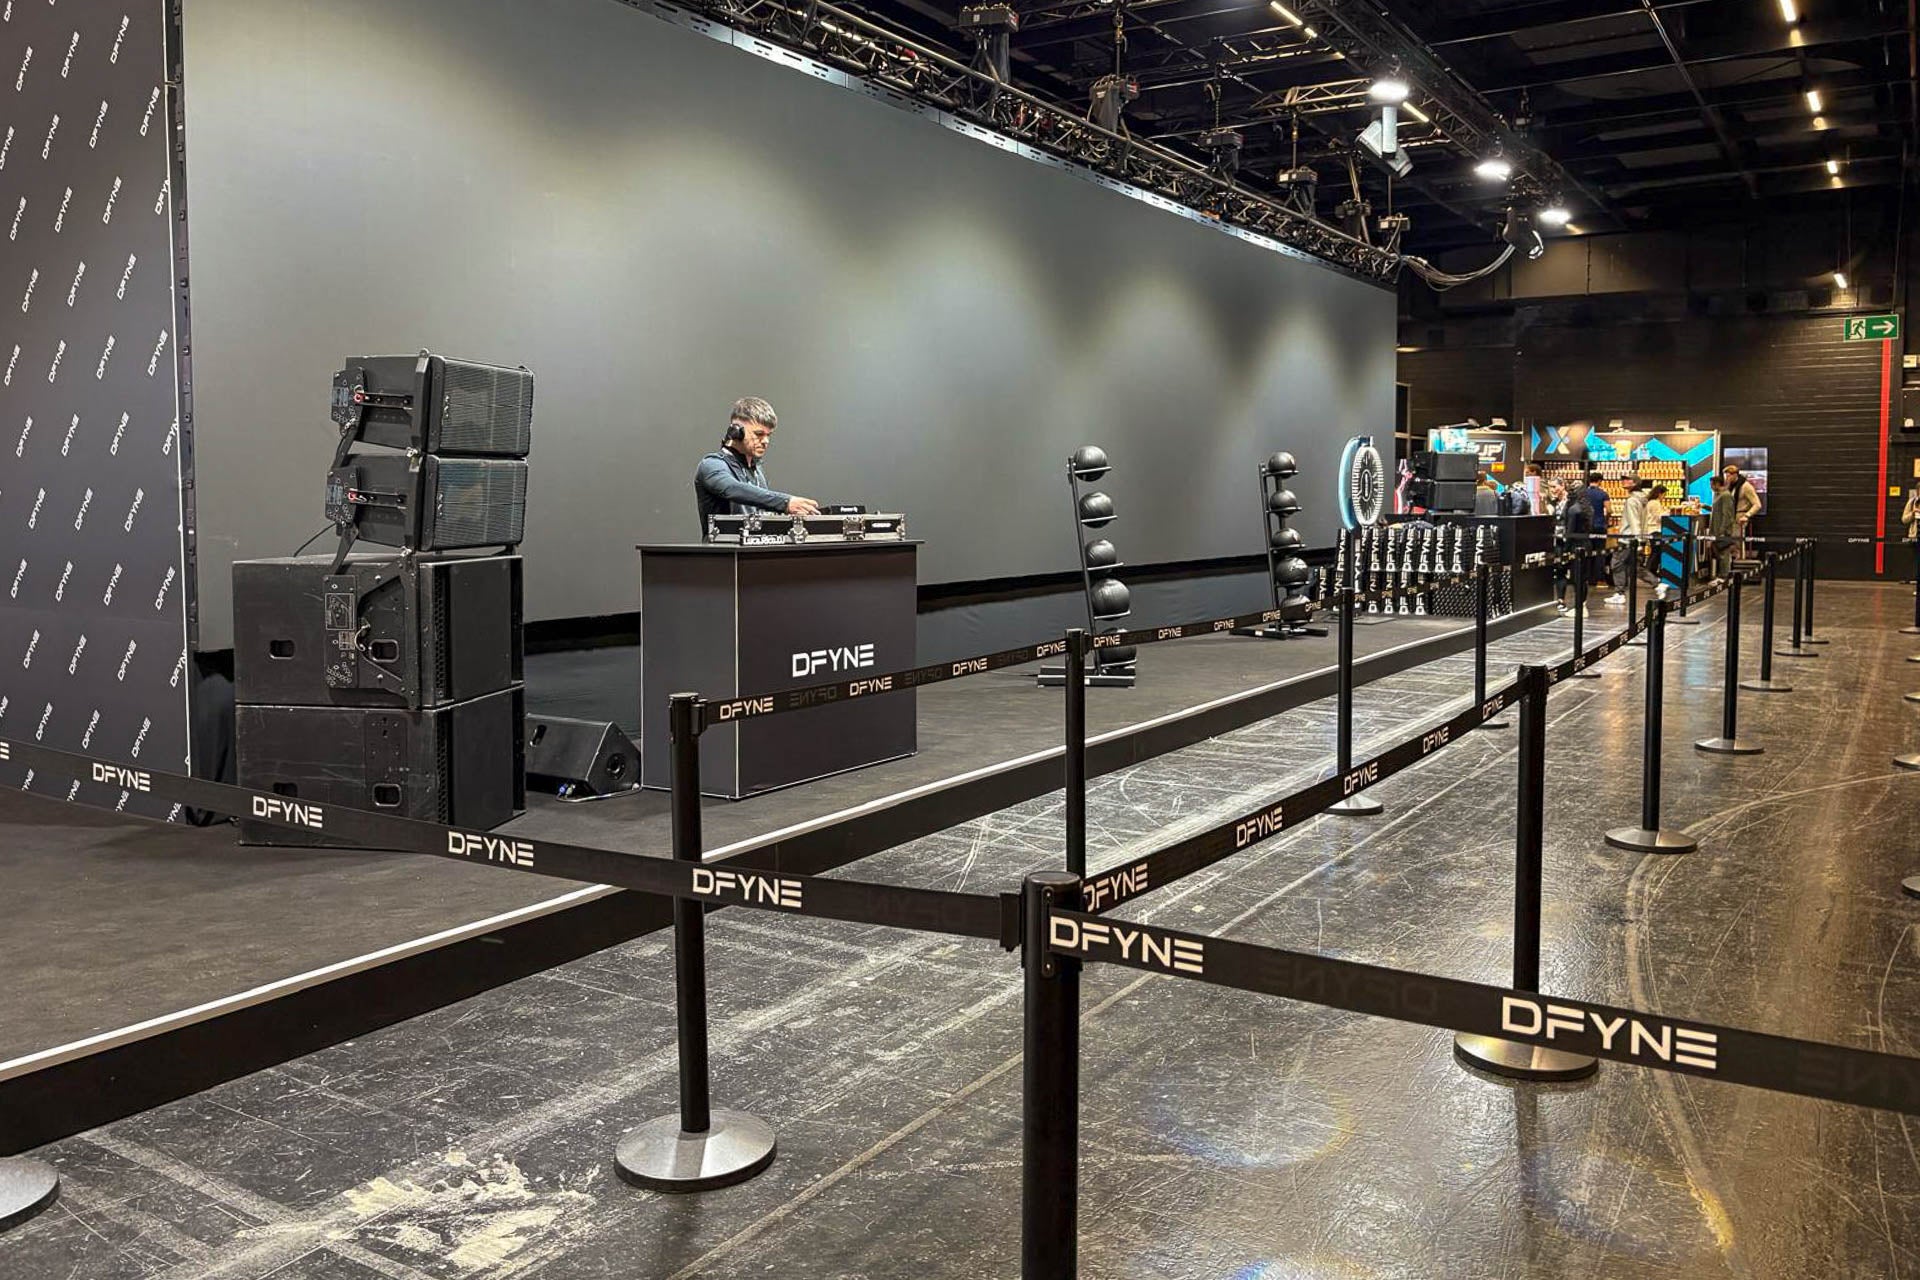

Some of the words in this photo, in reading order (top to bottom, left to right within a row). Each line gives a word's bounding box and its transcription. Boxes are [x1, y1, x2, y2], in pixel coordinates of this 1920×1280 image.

[61, 32, 79, 78] DFYNE
[110, 16, 129, 64] DFYNE
[16, 47, 32, 91] DFYNE
[90, 101, 108, 148] DFYNE
[140, 87, 160, 136] DFYNE
[42, 115, 59, 159] DFYNE
[10, 197, 26, 240] DFYNE
[55, 187, 72, 232] DFYNE
[103, 177, 121, 224] DFYNE
[22, 269, 38, 312] DFYNE
[68, 262, 85, 306] DFYNE
[117, 254, 136, 299] DFYNE
[5, 345, 20, 385] DFYNE
[49, 340, 66, 382] DFYNE
[97, 336, 115, 379] DFYNE
[148, 330, 168, 376] DFYNE
[16, 417, 32, 457] DFYNE
[62, 414, 79, 456] DFYNE
[111, 412, 129, 455] DFYNE
[29, 488, 45, 528] DFYNE
[75, 488, 92, 530] DFYNE
[125, 488, 143, 532] DFYNE
[1386, 528, 1396, 571] DFYNE
[1419, 529, 1429, 571] DFYNE
[1435, 528, 1444, 572] DFYNE
[1452, 528, 1462, 572] DFYNE
[1474, 525, 1484, 571] FYNE
[11, 559, 27, 598] DFYNE
[56, 561, 72, 601] DFYNE
[104, 564, 122, 605] DFYNE
[155, 567, 175, 610] DFYNE
[1158, 626, 1182, 640] DFYNE
[1214, 619, 1236, 632] DFYNE
[1262, 609, 1281, 621] DFYNE
[24, 630, 39, 668] DFYNE
[69, 635, 86, 674] DFYNE
[118, 640, 136, 680] DFYNE
[792, 644, 874, 677] DFYNE
[1036, 641, 1066, 657] DFYNE
[1093, 635, 1120, 648] DFYNE
[850, 676, 892, 697] DFYNE
[952, 658, 987, 676] DFYNE
[36, 703, 52, 740] DFYNE
[720, 697, 773, 720] DFYNE
[1482, 695, 1503, 719] DFYNE
[82, 710, 99, 749] DFYNE
[132, 718, 151, 757] DFYNE
[1423, 727, 1449, 753] DFYNE
[92, 763, 150, 792] DFYNE
[1344, 762, 1378, 795] DFYNE
[253, 796, 323, 828] DFYNE
[1236, 807, 1283, 847] DFYNE
[448, 831, 534, 867] DFYNE
[692, 868, 802, 908] DFYNE
[1050, 916, 1203, 973] DFYNE
[1502, 997, 1718, 1070] DFYNE
